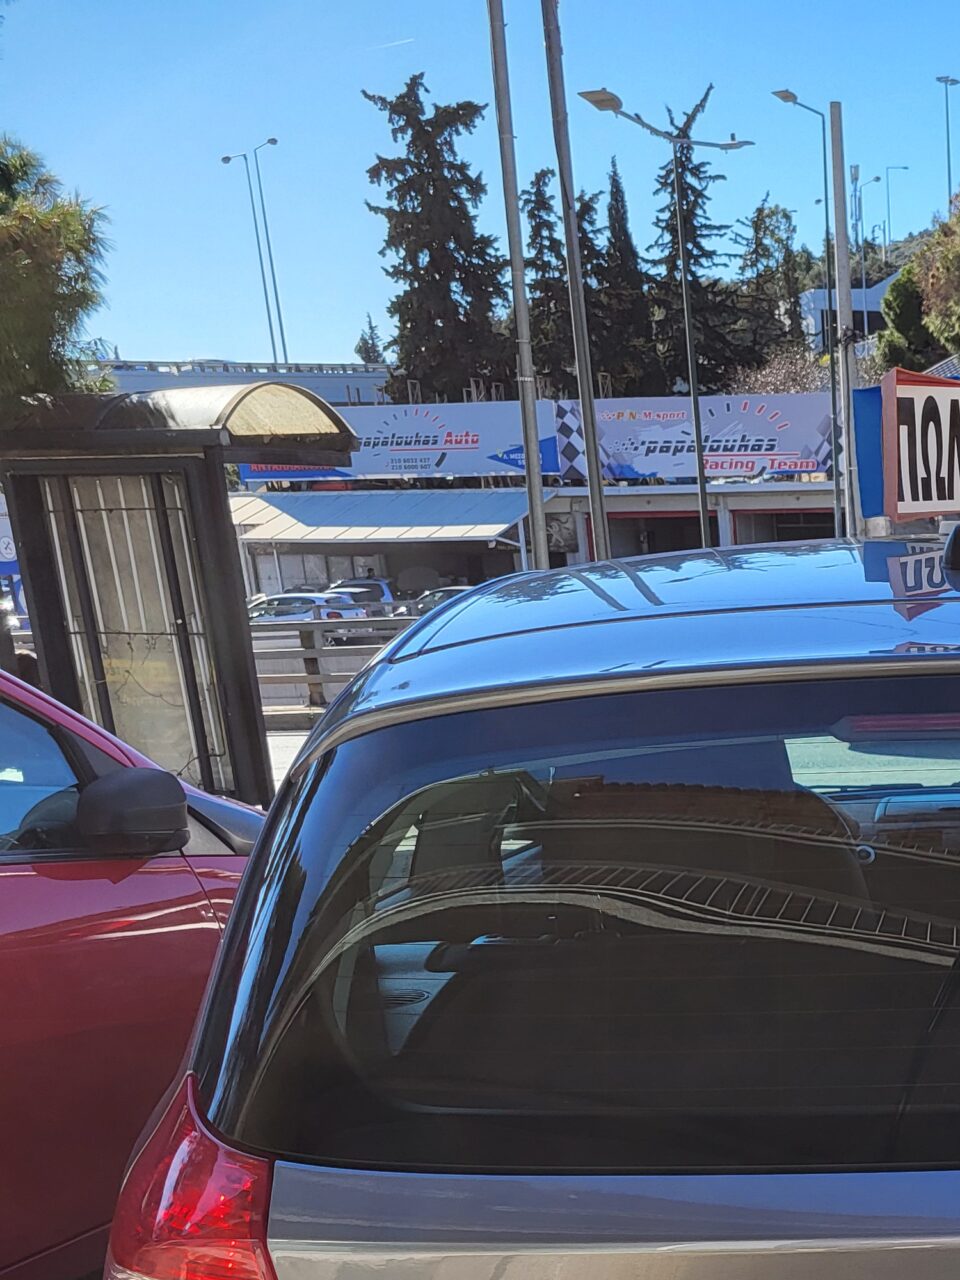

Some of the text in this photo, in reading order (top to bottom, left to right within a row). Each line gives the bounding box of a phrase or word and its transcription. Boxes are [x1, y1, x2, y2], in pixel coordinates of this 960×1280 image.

[358, 431, 480, 449] apaloukas Auto
[703, 458, 818, 473] Racing Team
